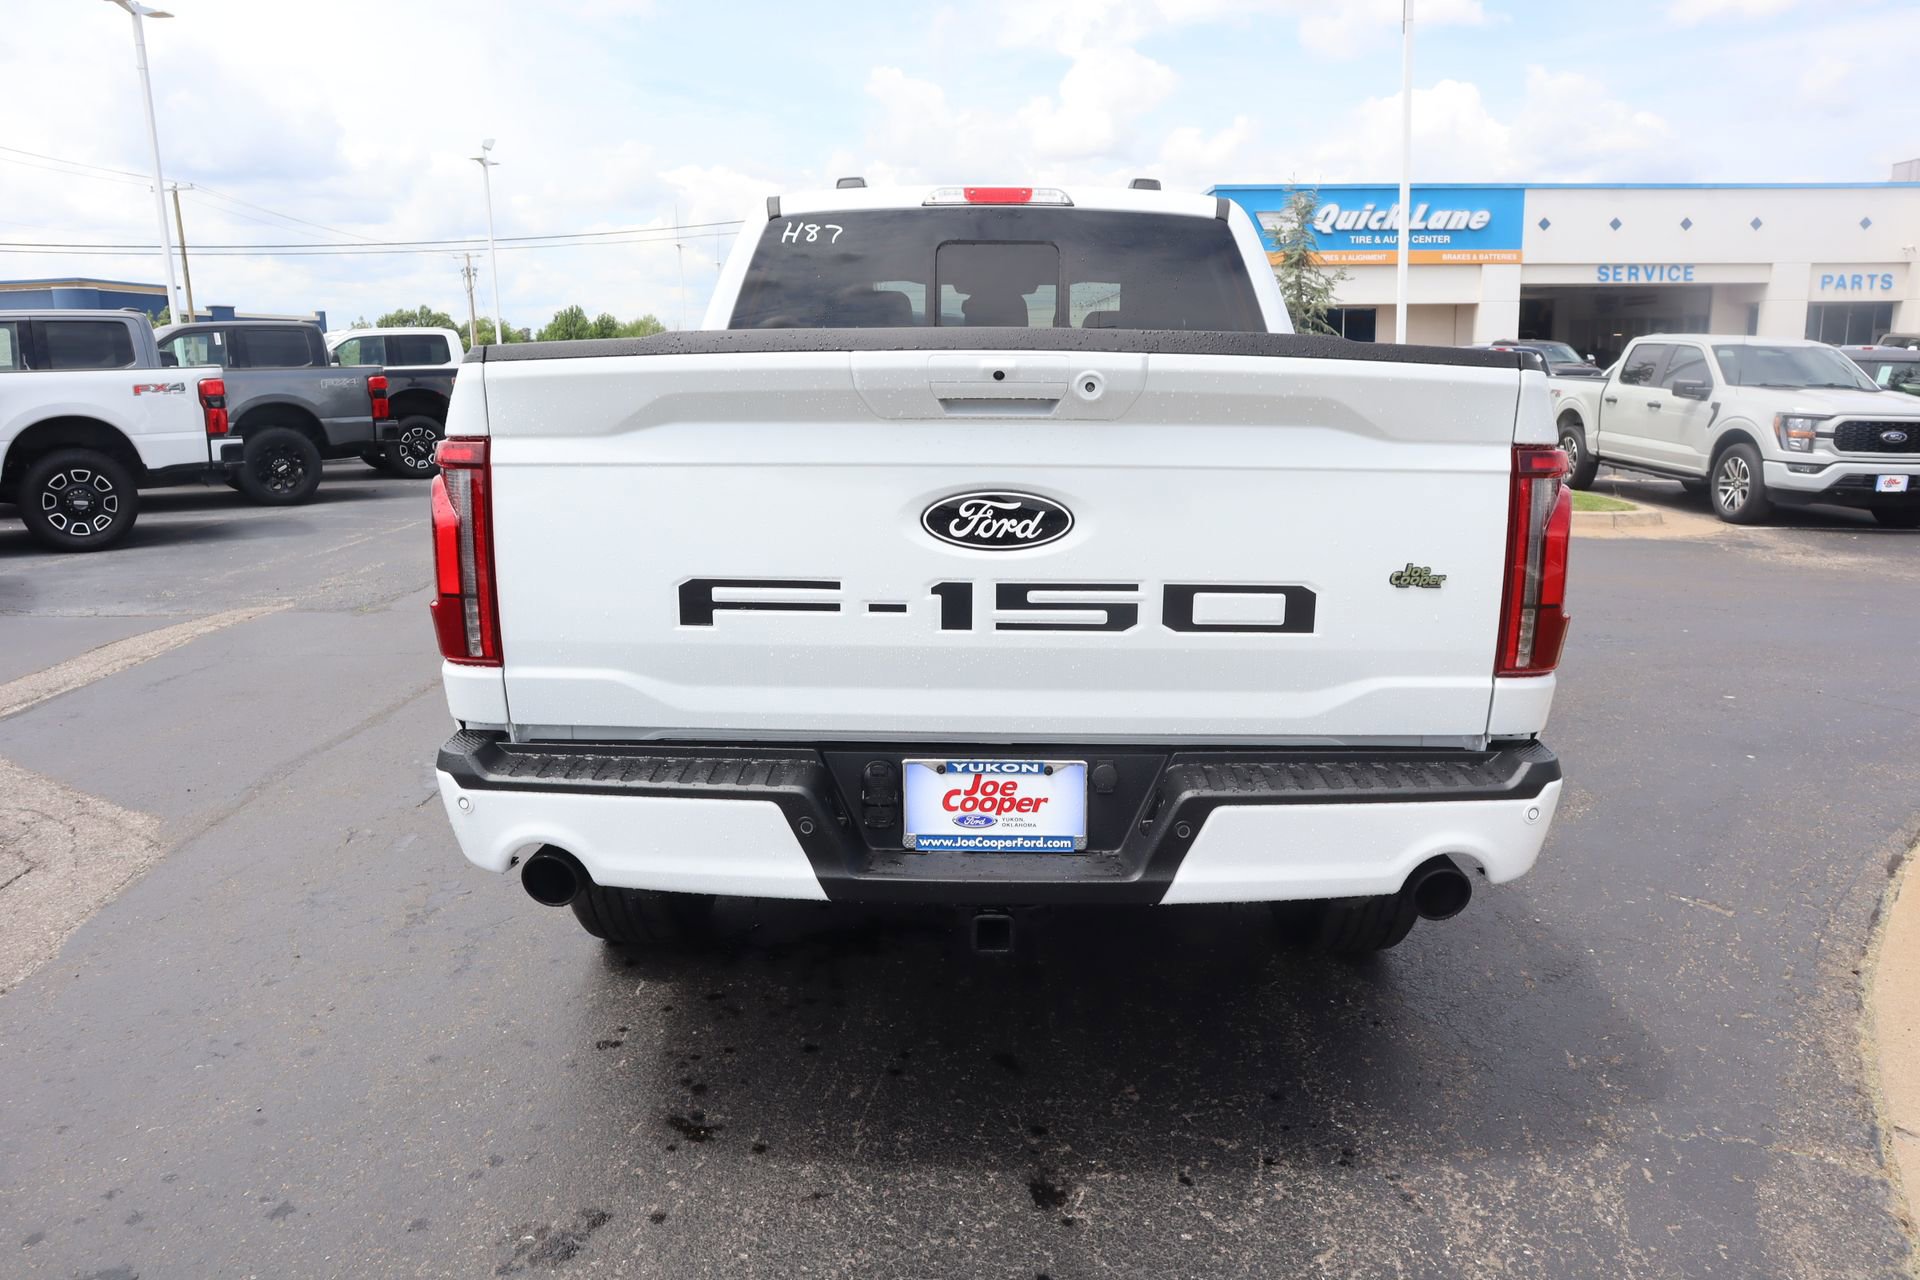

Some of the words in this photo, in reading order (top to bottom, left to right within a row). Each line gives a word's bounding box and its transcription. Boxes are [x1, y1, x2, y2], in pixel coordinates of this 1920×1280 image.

[781, 221, 843, 244] H87
[1350, 235, 1372, 244] TIRE
[1374, 235, 1381, 244] &
[1383, 235, 1409, 244] AUT
[1412, 235, 1450, 244] CENTER
[1597, 264, 1696, 282] SERVICE
[1820, 274, 1894, 291] PARTS
[133, 382, 186, 396] FX4
[948, 498, 1046, 540] Ford
[1403, 562, 1431, 577] Joe
[1389, 571, 1447, 587] Cooper
[678, 577, 1318, 634] F-150
[952, 763, 1039, 773] YUKON
[963, 774, 1018, 797] Joe
[942, 789, 1049, 816] Cooper
[963, 814, 986, 826] Ford
[919, 836, 1072, 850] www.JoeCooperFord.com
